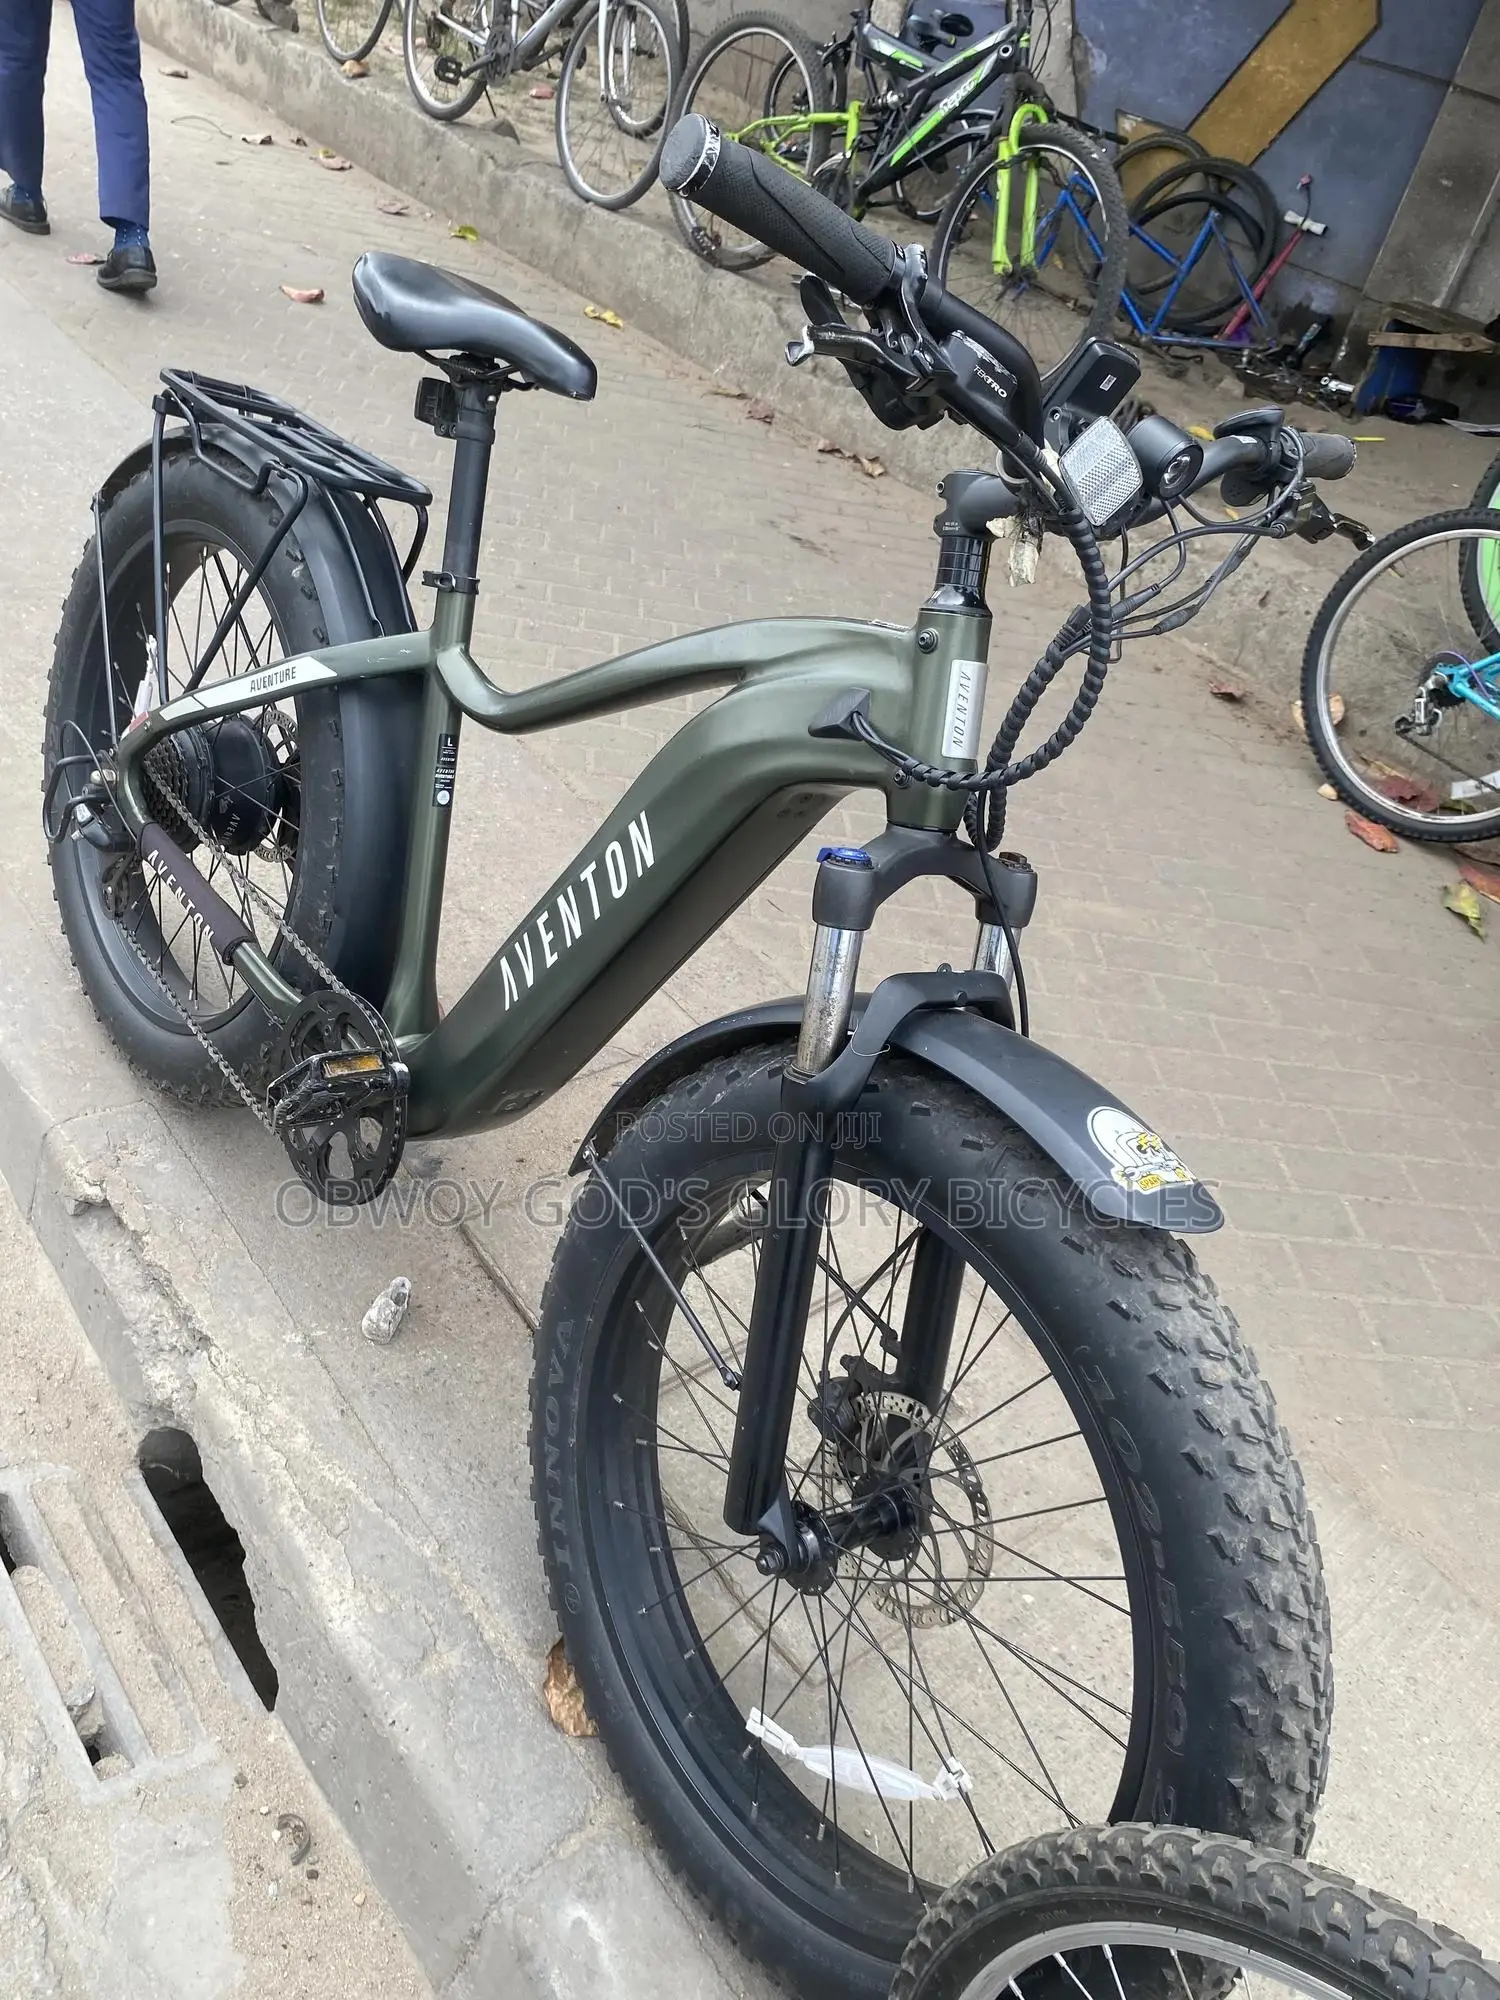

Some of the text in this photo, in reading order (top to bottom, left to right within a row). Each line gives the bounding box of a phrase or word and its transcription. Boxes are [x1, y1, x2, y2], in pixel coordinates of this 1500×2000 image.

[973, 364, 1007, 398] TEKTRO
[250, 666, 297, 693] AVENTURE
[952, 671, 971, 748] AVENTON
[447, 737, 453, 747] L
[147, 849, 215, 939] AVENTON
[500, 810, 655, 1011] AVENTON
[545, 1319, 576, 1572] INNOVA
